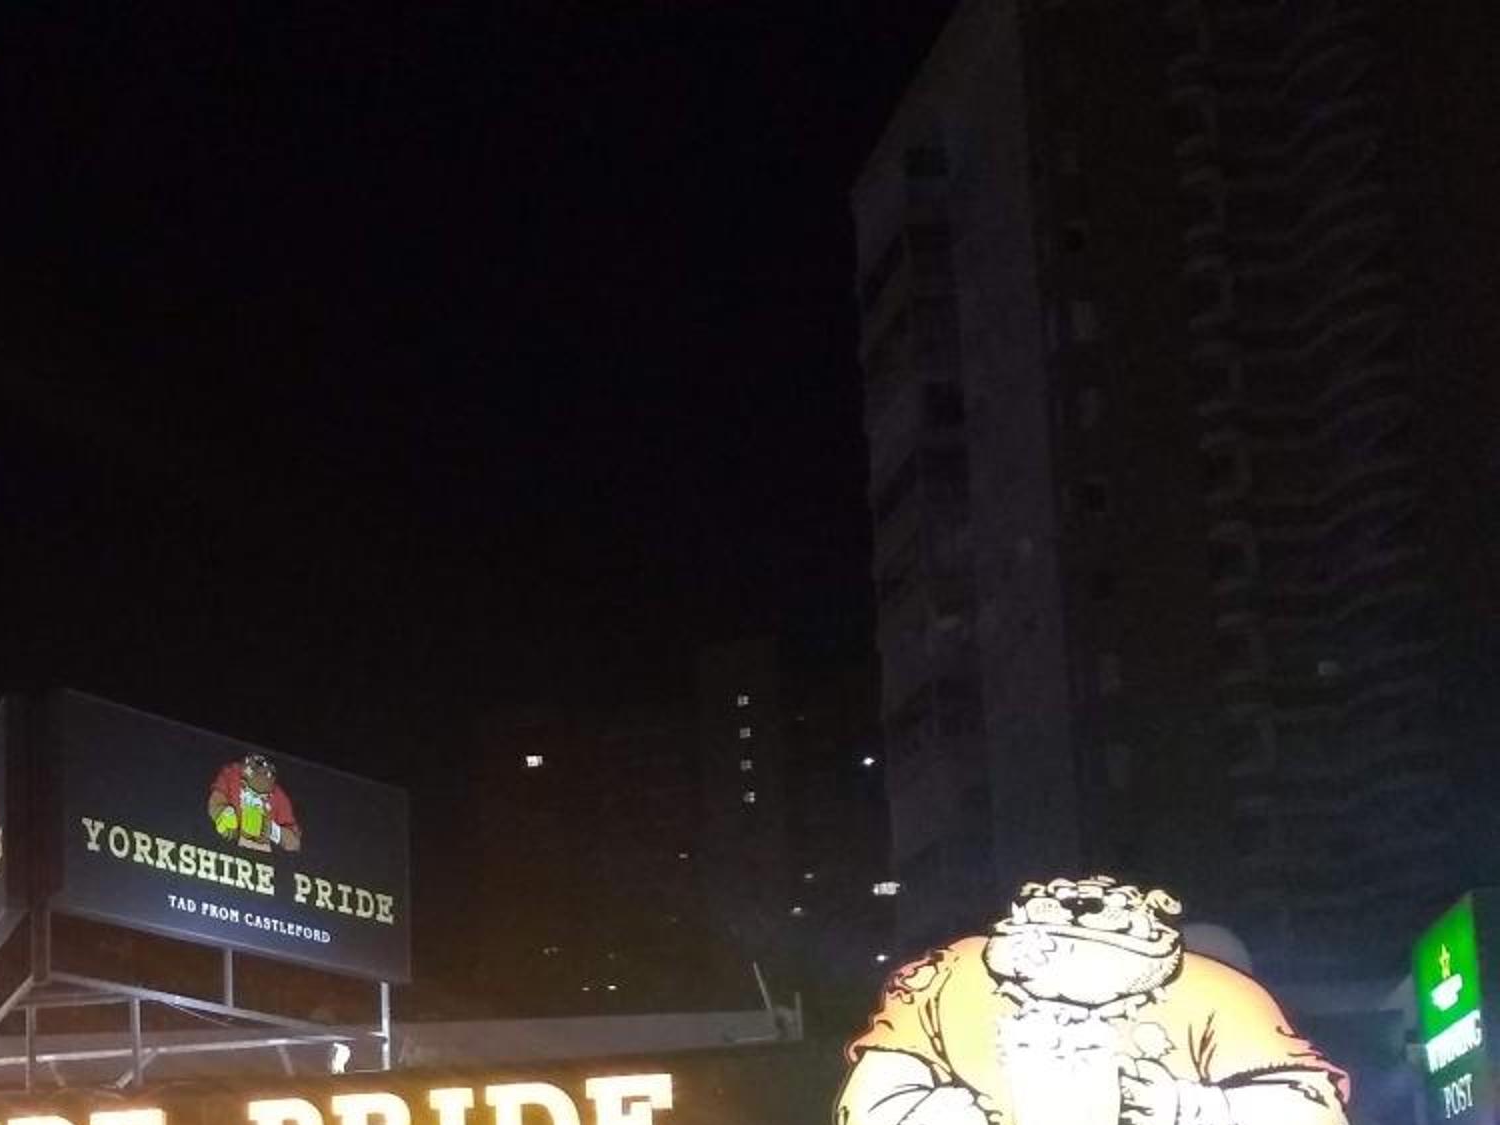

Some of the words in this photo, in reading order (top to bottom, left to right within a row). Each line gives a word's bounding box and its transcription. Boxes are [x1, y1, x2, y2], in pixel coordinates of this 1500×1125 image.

[82, 817, 275, 896] YORKSHIRE
[294, 873, 395, 925] PRIDE
[168, 895, 197, 914] TAD
[201, 902, 240, 924] FROM
[245, 913, 332, 944] CASTLEFORD
[1443, 1073, 1474, 1118] POST
